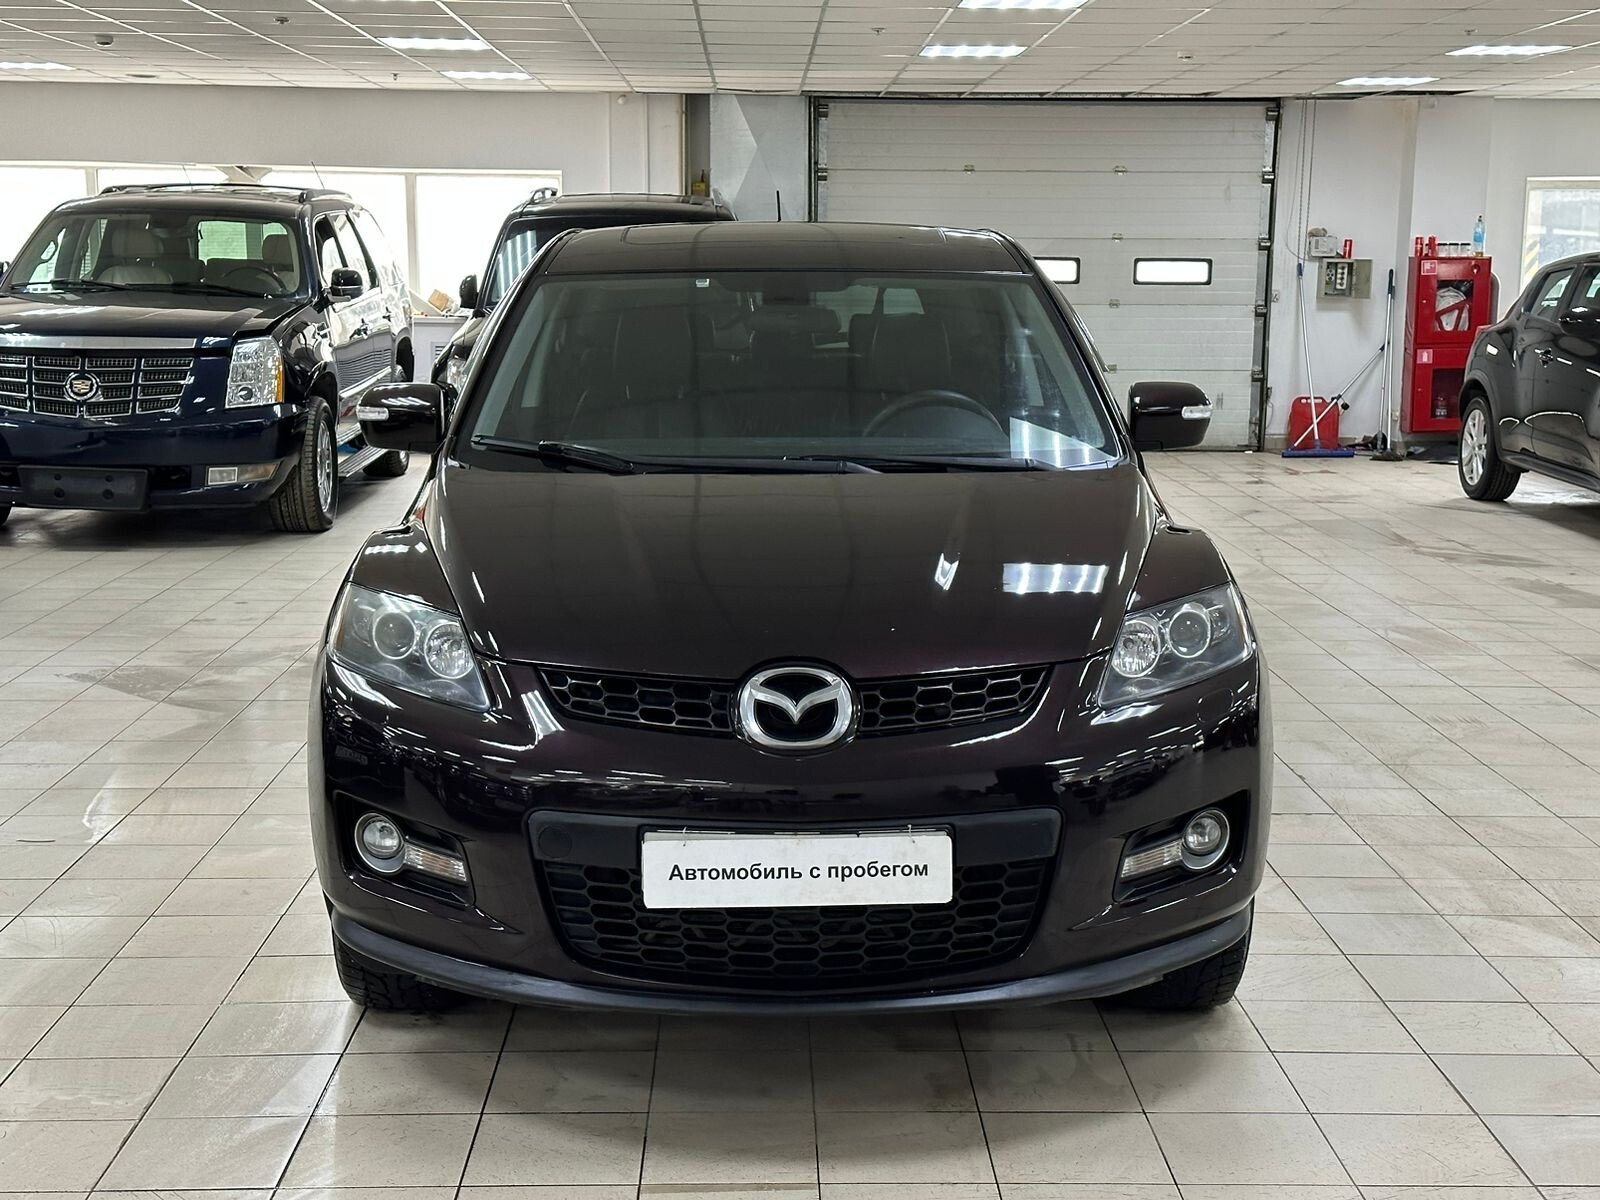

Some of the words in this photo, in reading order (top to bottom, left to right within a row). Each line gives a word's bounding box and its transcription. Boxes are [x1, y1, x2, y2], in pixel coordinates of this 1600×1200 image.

[668, 862, 803, 881] Автомобиль
[809, 865, 821, 880] с
[827, 860, 928, 883] пробегом
